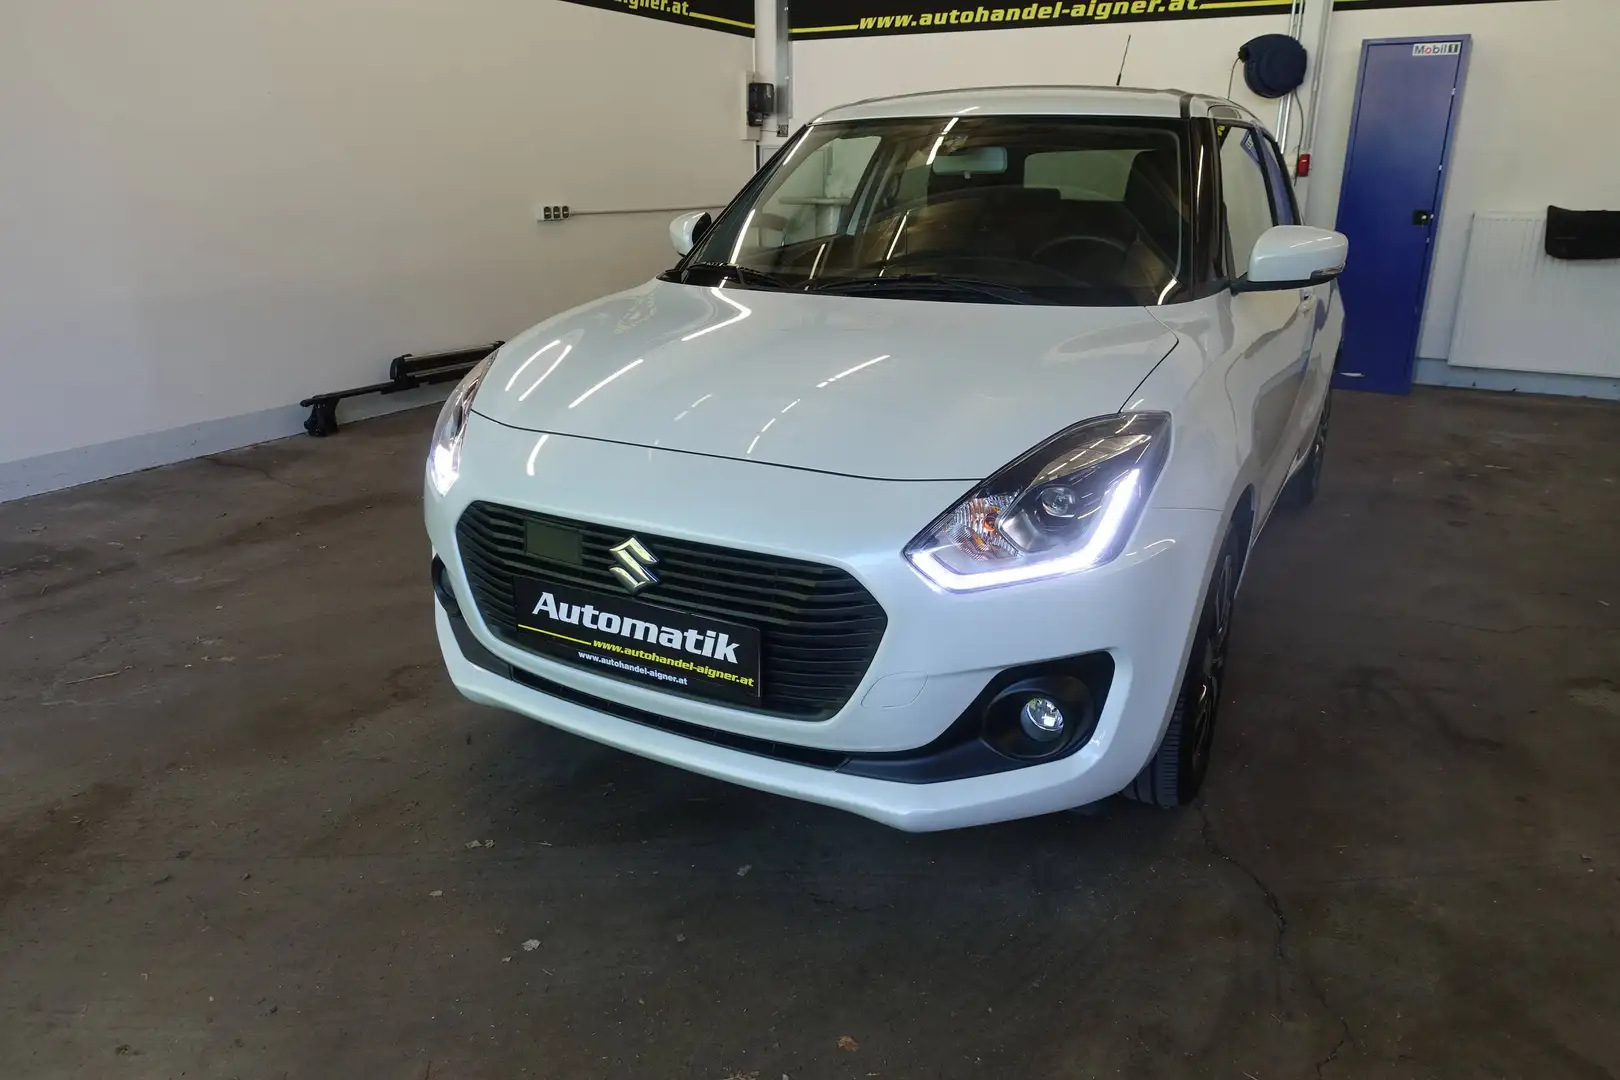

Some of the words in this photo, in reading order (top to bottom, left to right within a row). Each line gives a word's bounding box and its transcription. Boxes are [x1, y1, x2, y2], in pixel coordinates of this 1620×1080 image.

[859, 0, 1198, 30] www.autohandel-aigner.at
[532, 591, 740, 664] Automatik
[578, 651, 688, 686] www.autohandel-aigner.at
[593, 639, 754, 687] www.autohandel-aigner.at
